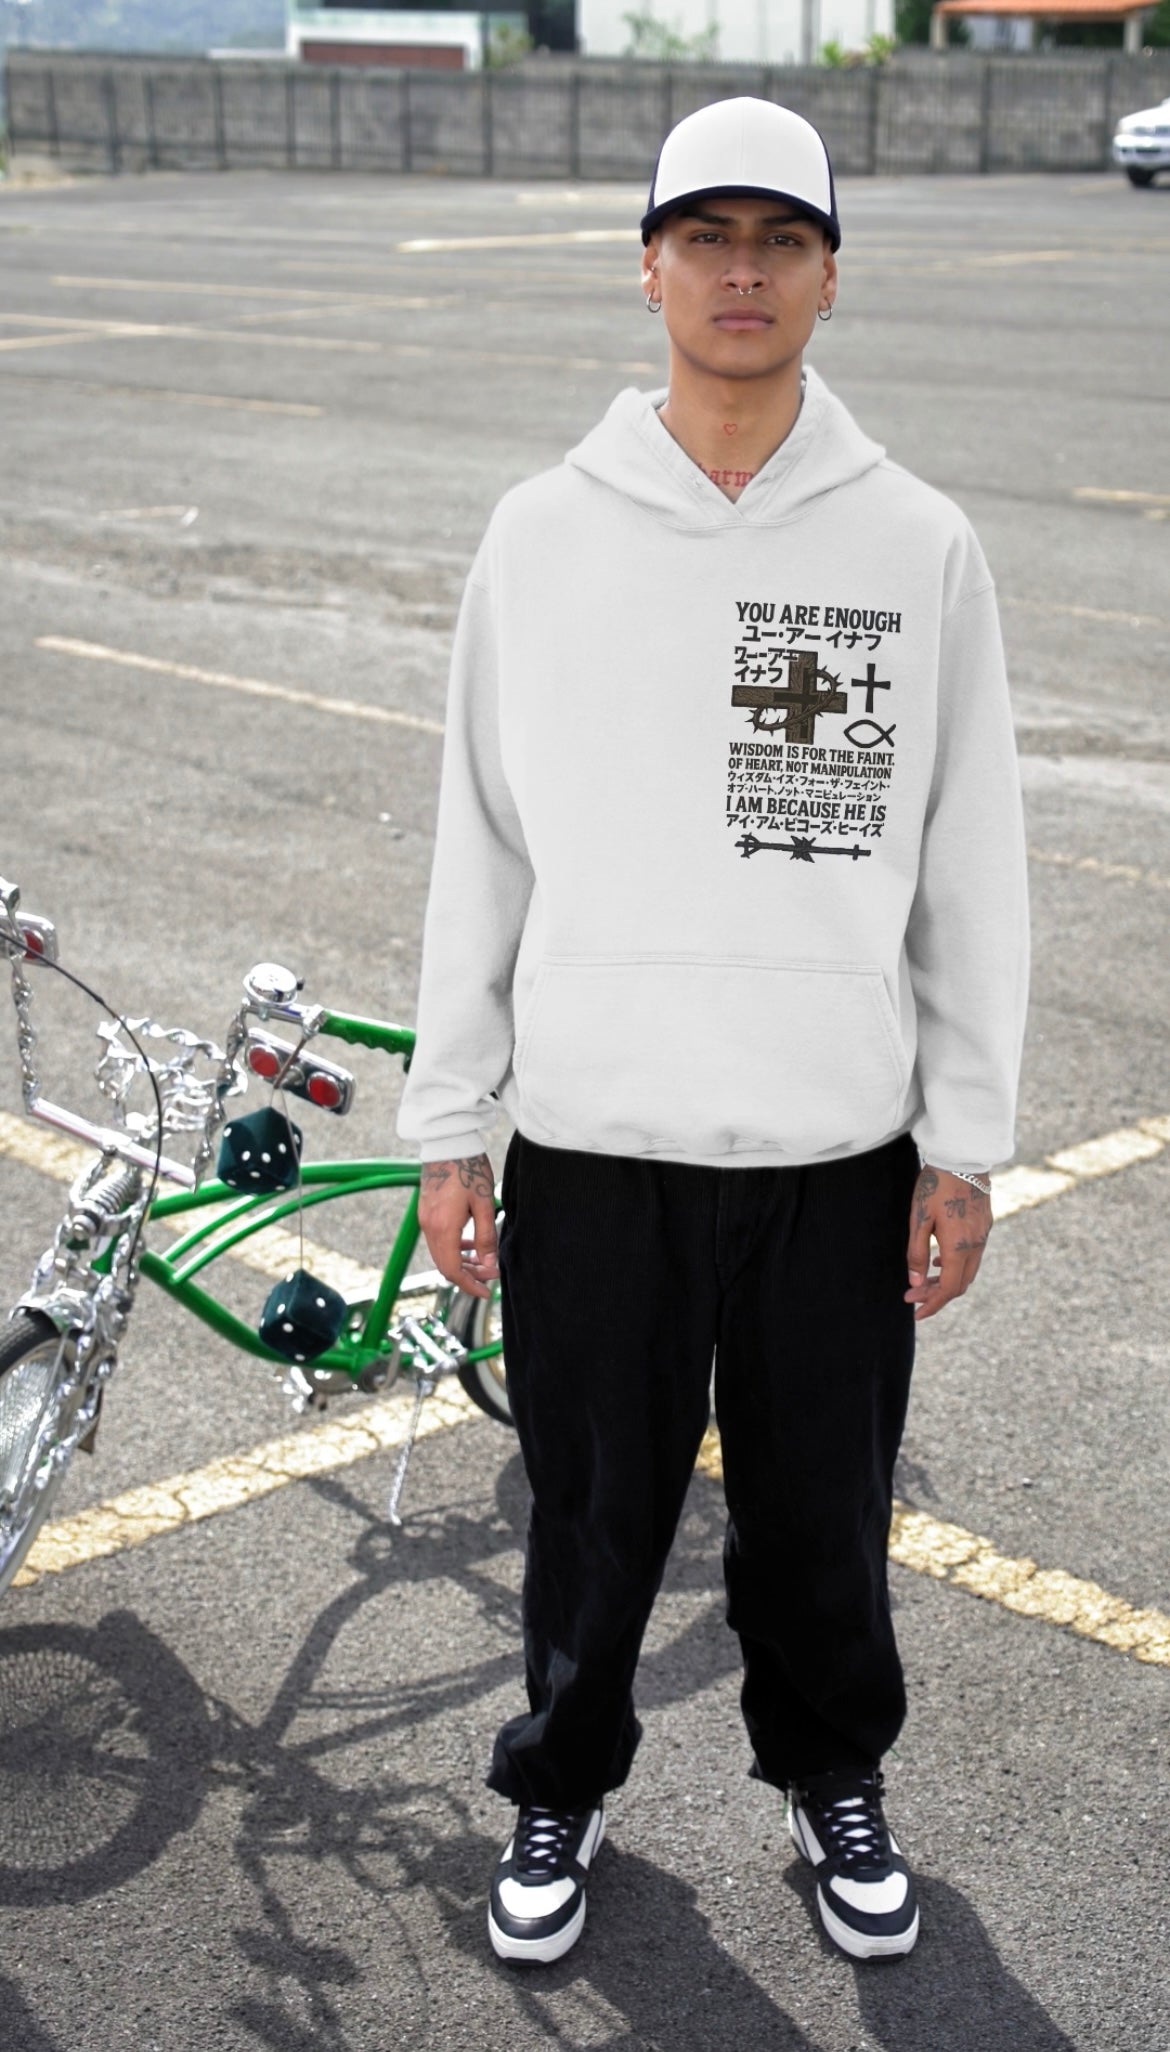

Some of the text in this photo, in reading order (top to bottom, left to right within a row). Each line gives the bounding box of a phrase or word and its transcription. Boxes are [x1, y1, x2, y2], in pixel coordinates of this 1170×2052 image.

[735, 601, 902, 633] YOU ARE ENOUGH
[734, 664, 783, 684] イナフ
[729, 742, 784, 758] WISDOM
[787, 745, 799, 759] IS
[801, 747, 827, 762] FOR
[829, 749, 854, 764] THE
[728, 757, 892, 780] OF HEART, NOT MANIPULATION
[726, 795, 887, 822] I AM BECAUSE HE IS
